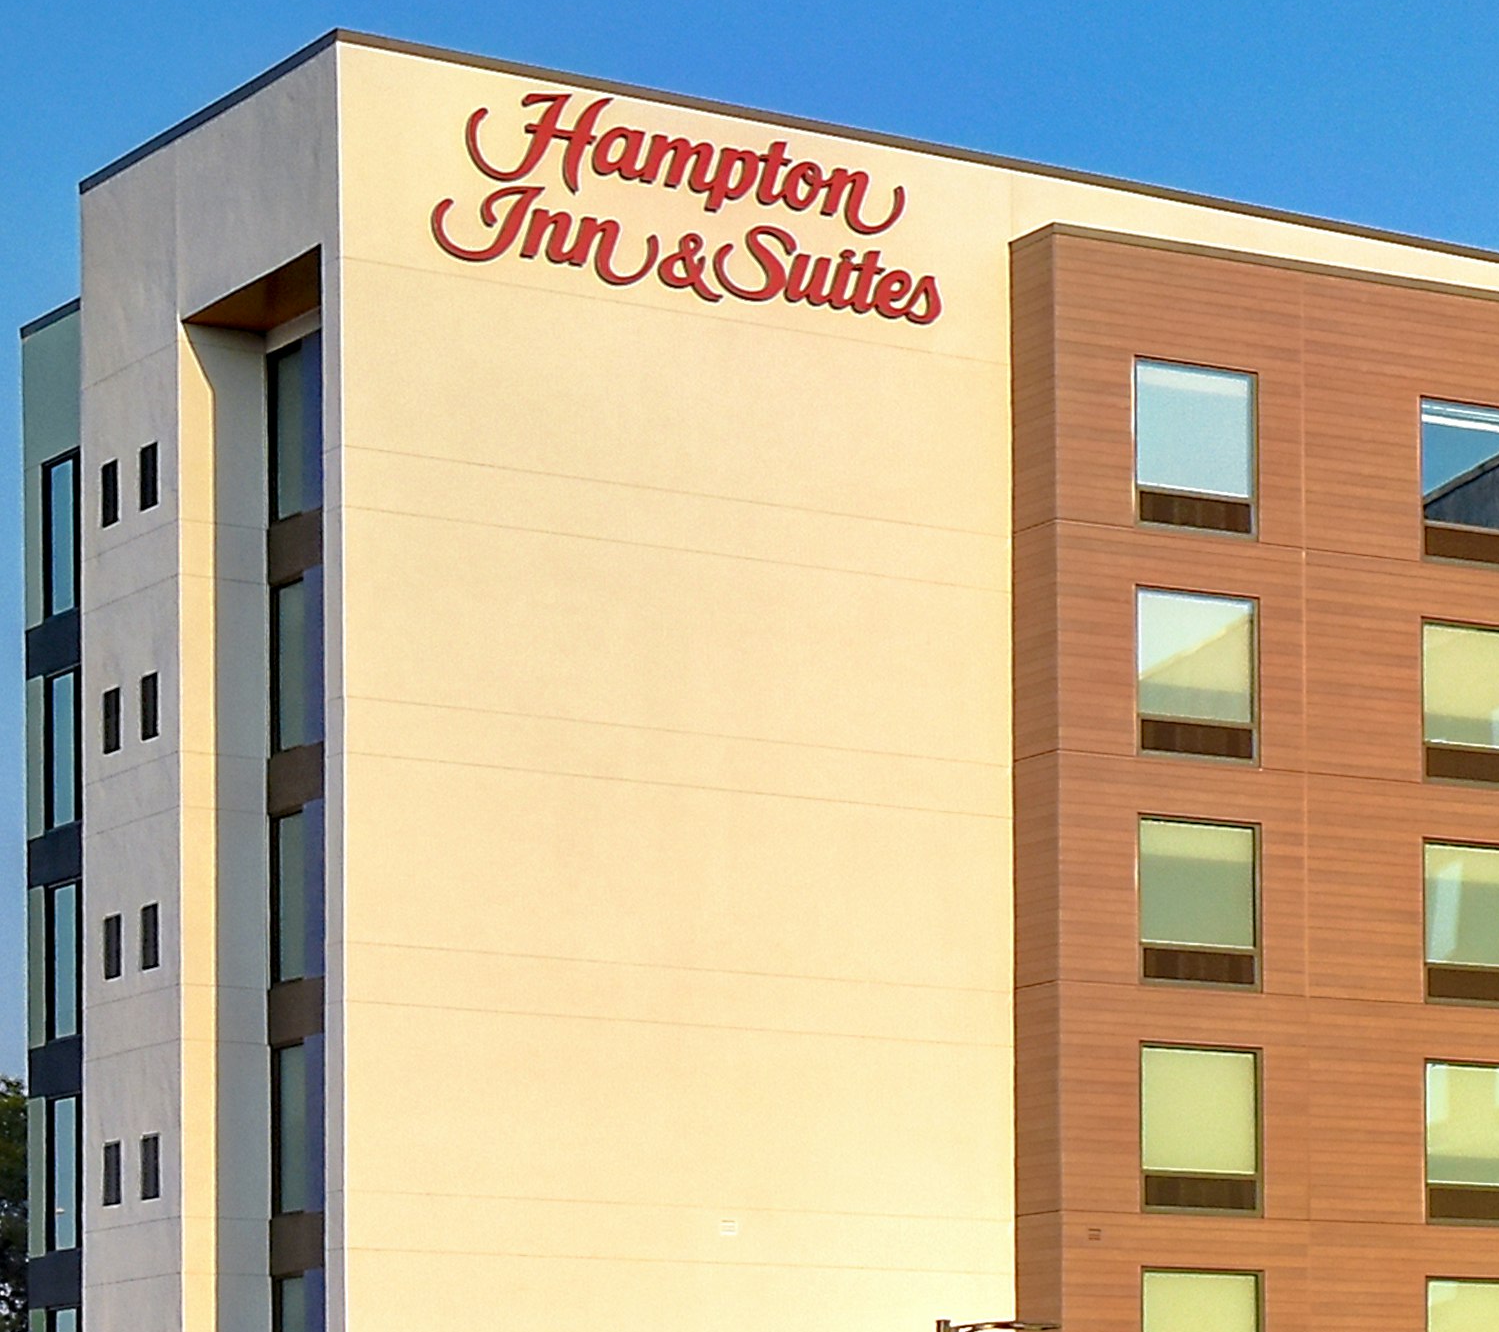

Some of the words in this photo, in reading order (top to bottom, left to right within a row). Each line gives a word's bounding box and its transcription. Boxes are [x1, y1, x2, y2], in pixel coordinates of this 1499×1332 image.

[465, 92, 906, 235] Hampton
[431, 185, 658, 287] Inn
[714, 225, 943, 325] Suites
